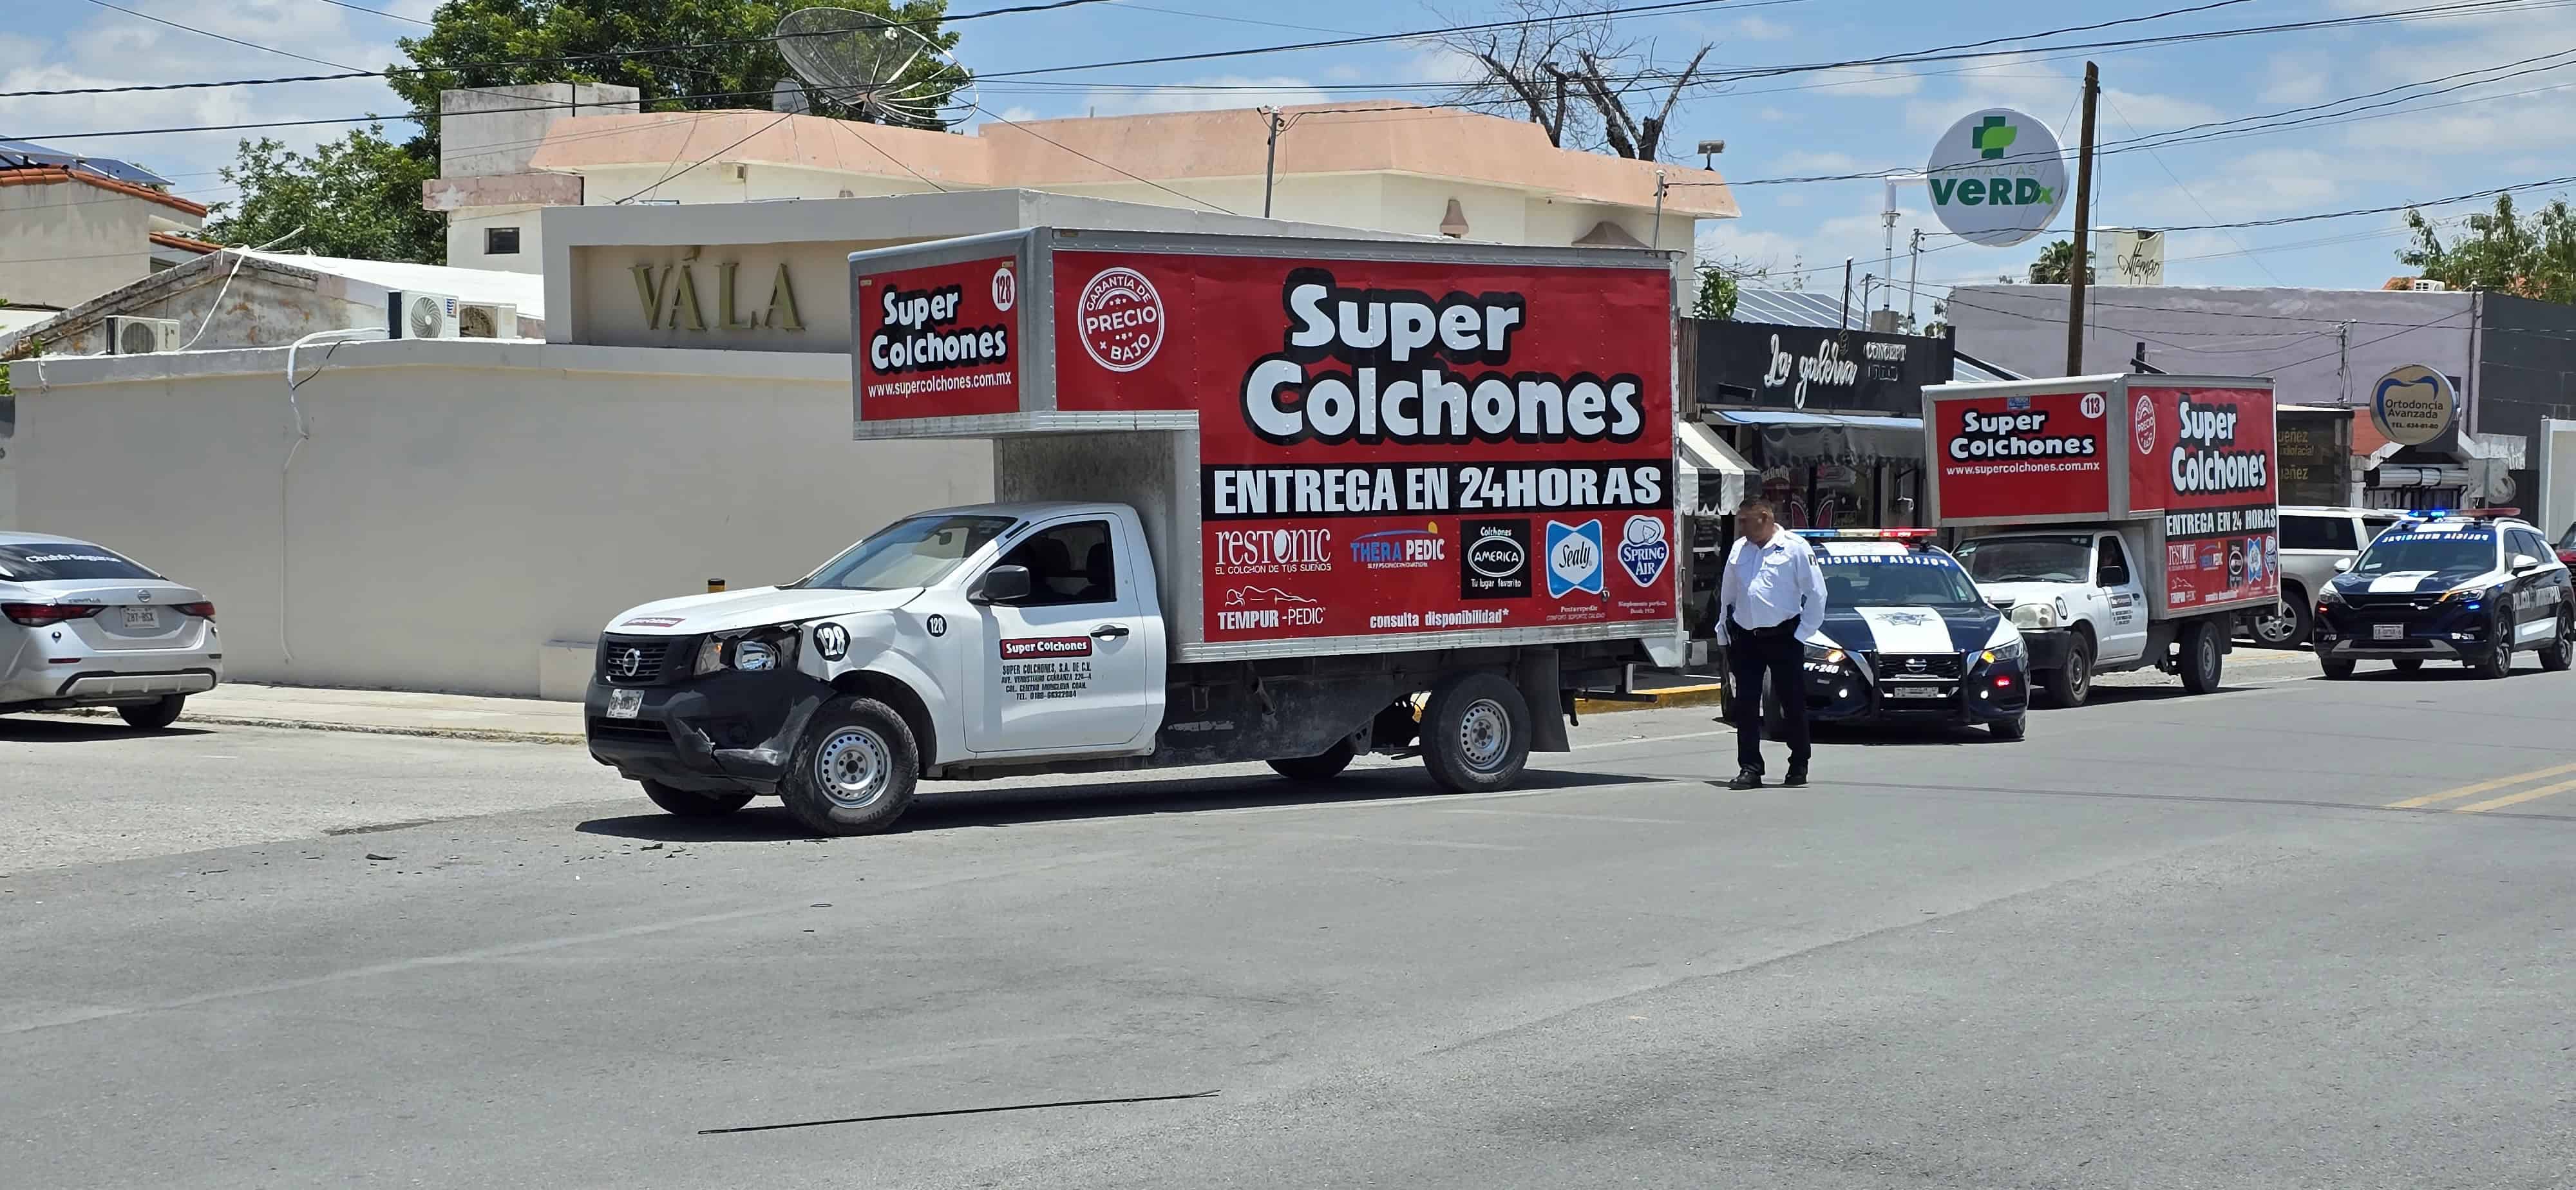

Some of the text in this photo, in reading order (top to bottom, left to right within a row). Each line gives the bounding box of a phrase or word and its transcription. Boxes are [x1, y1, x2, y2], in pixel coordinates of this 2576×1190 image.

[996, 275, 1011, 304] 128
[1086, 274, 1152, 311] GARANTÍA DE
[884, 292, 958, 330] Super
[1086, 306, 1157, 335] PRECIO
[1290, 283, 1519, 362] Super
[871, 330, 1007, 370] Colchones
[1110, 334, 1150, 361] BAJO
[1865, 341, 1907, 361] CONCEPT
[1763, 334, 1793, 388] La
[867, 371, 1012, 399] www.supercolchones.com.mx
[1245, 359, 1641, 437] Colchones
[2085, 397, 2100, 414] 113
[2385, 399, 2443, 410] Ortodoncia
[1965, 412, 2045, 435] Super
[2179, 401, 2237, 446] Super
[2387, 409, 2438, 419] Avanzada
[1950, 437, 2094, 458] Colchones
[1946, 461, 2100, 476] www.supercolchones.com.mx
[2172, 446, 2266, 491] Colchones
[1214, 468, 1398, 515] ENTREGA
[1406, 468, 1449, 510] EN
[1480, 525, 1512, 537] Colchones
[2166, 508, 2276, 536] ENTREGA EN 24 HORAS
[1350, 538, 1445, 563] THERA PEDIC
[1473, 551, 1519, 562] AMERICA
[1558, 542, 1591, 569] Sealy
[1623, 547, 1665, 561] SPRING
[1215, 567, 1225, 575] EL
[1267, 564, 1279, 573] DE
[1282, 564, 1298, 573] TUS
[1300, 562, 1331, 572] SUEÑOS
[1635, 562, 1656, 576] AIR
[1470, 578, 1522, 590] Tu lugar favorito
[929, 618, 943, 634] 128
[1217, 609, 1279, 630] TEMPUR
[1370, 612, 1419, 628] consulta
[817, 625, 846, 656] 128
[1006, 641, 1087, 655] Super Colchones
[1002, 665, 1021, 675] SUPER
[1059, 662, 1070, 673] S.A.
[1072, 662, 1079, 672] DE
[1081, 661, 1092, 672] C.V.
[1046, 674, 1073, 682] CARRANZA
[1019, 684, 1039, 692] CENTRO
